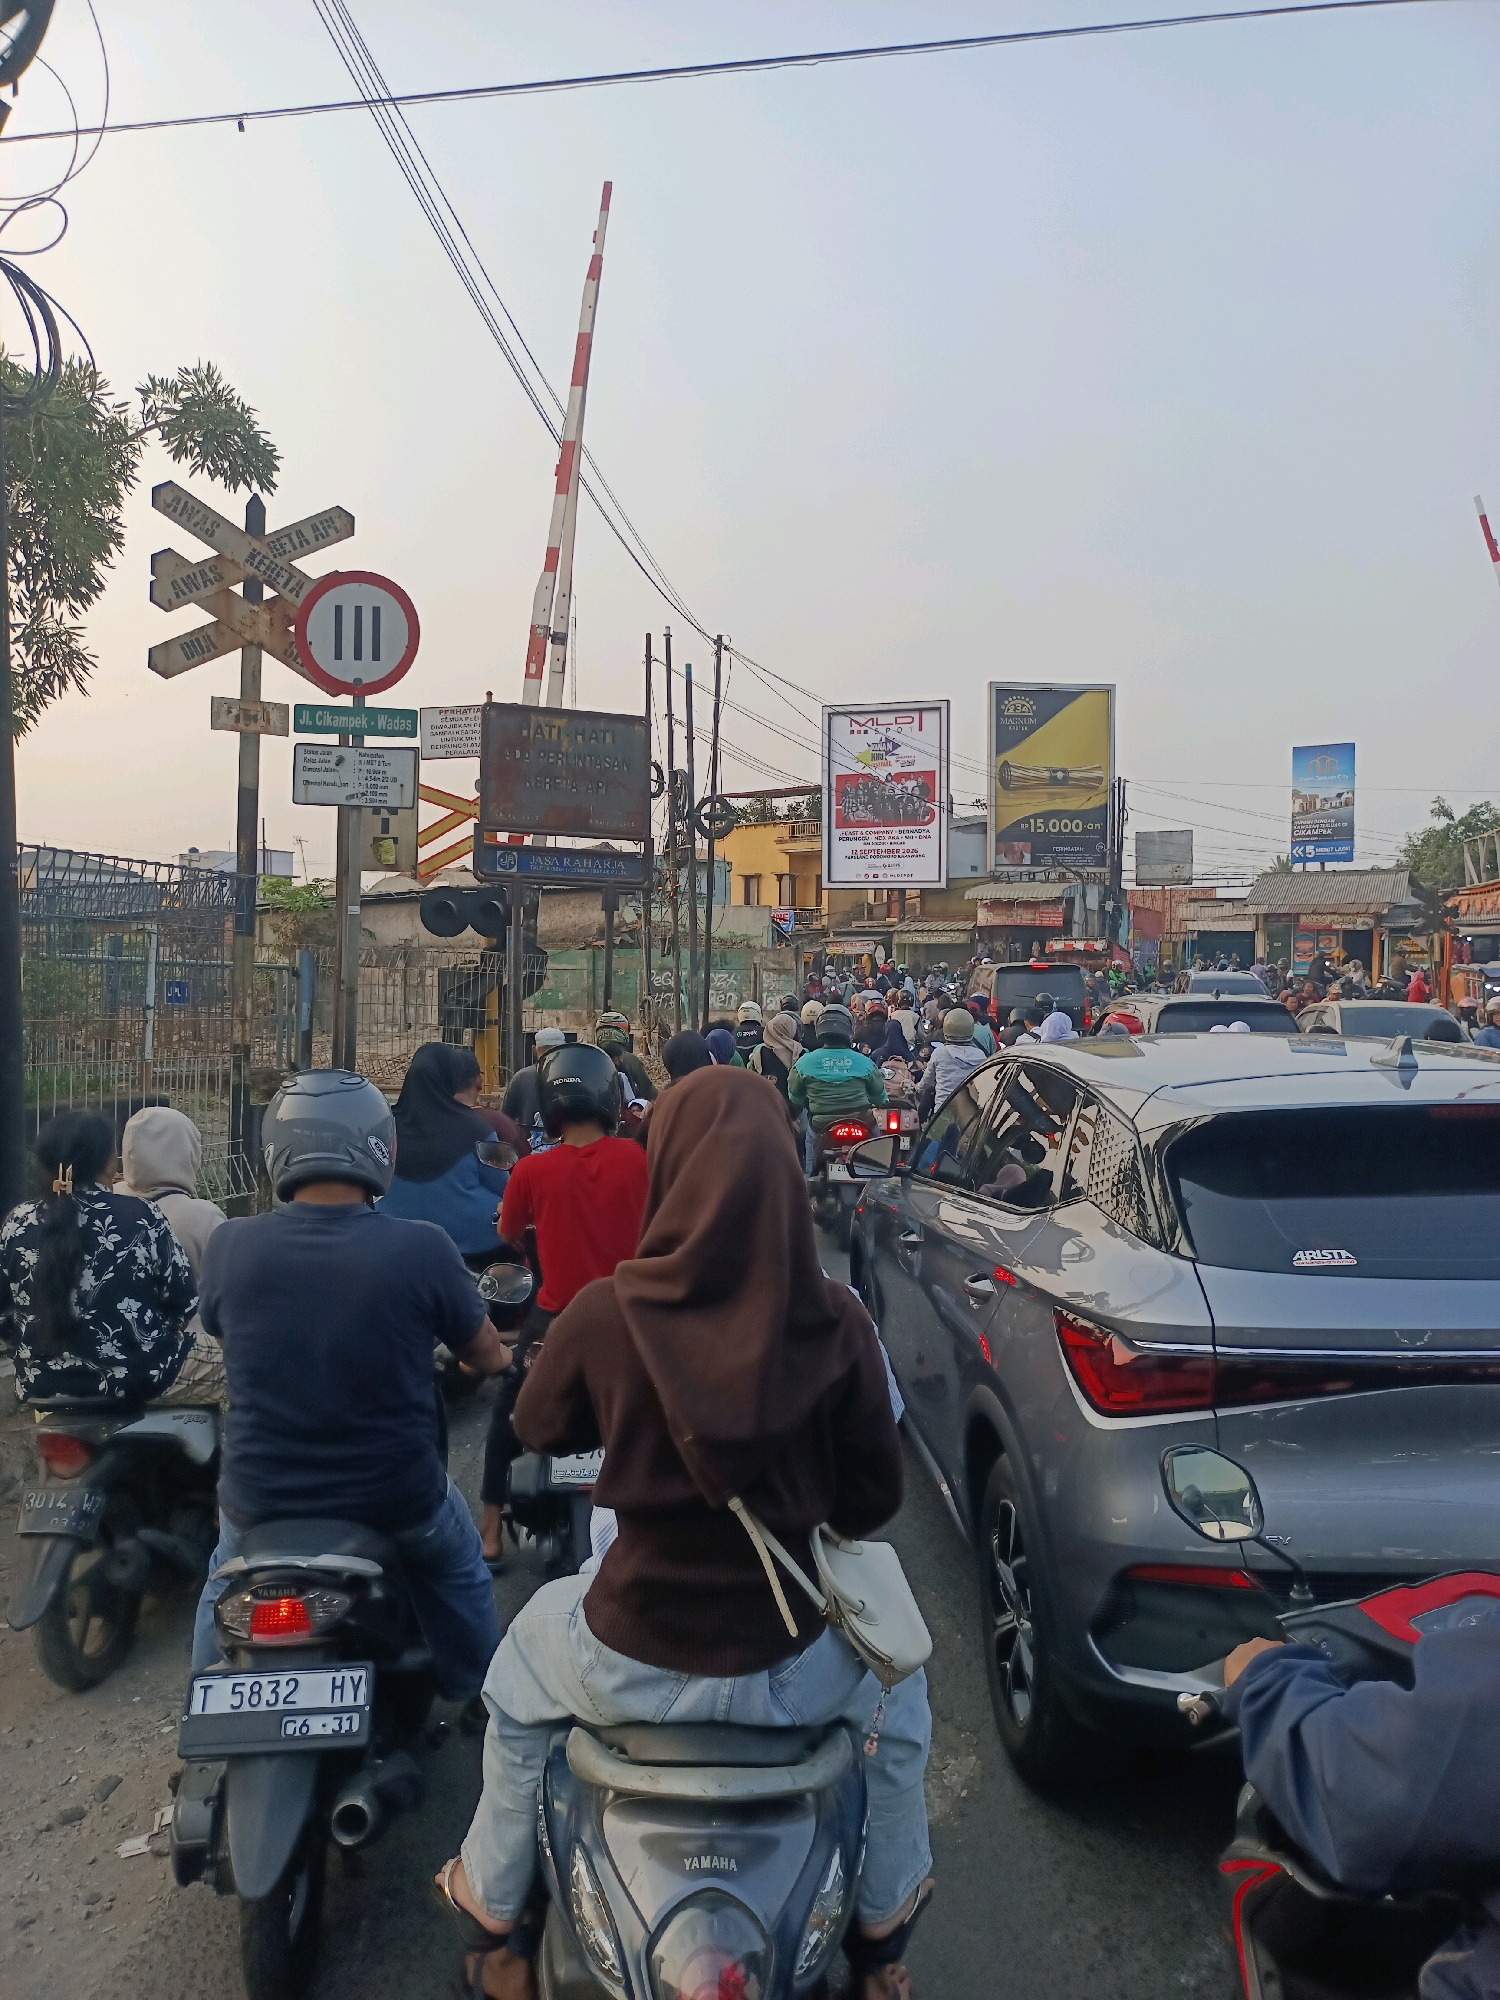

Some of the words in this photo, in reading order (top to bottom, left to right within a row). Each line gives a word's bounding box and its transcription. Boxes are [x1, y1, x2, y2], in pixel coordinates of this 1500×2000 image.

[164, 495, 220, 538] AWAS
[245, 547, 305, 598] KERETA
[170, 564, 224, 599] AWAS
[311, 516, 339, 541] API
[1008, 703, 1030, 713] 234
[299, 710, 312, 726] Jl.
[315, 711, 368, 731] Cikampek
[377, 714, 412, 731] Wadas
[540, 750, 630, 771] PERLINTASAN
[1306, 845, 1316, 858] 5
[530, 855, 560, 866] JASA
[563, 857, 626, 870] RAHARJA
[822, 1056, 852, 1067] Grab
[553, 1078, 582, 1086] HONDA
[1293, 1250, 1356, 1260] ARISTA
[258, 1588, 296, 1598] YAMAHA
[200, 1684, 214, 1713] T
[230, 1677, 299, 1710] 5832
[330, 1675, 363, 1704] HY
[684, 1856, 738, 1872] YAMAHA
